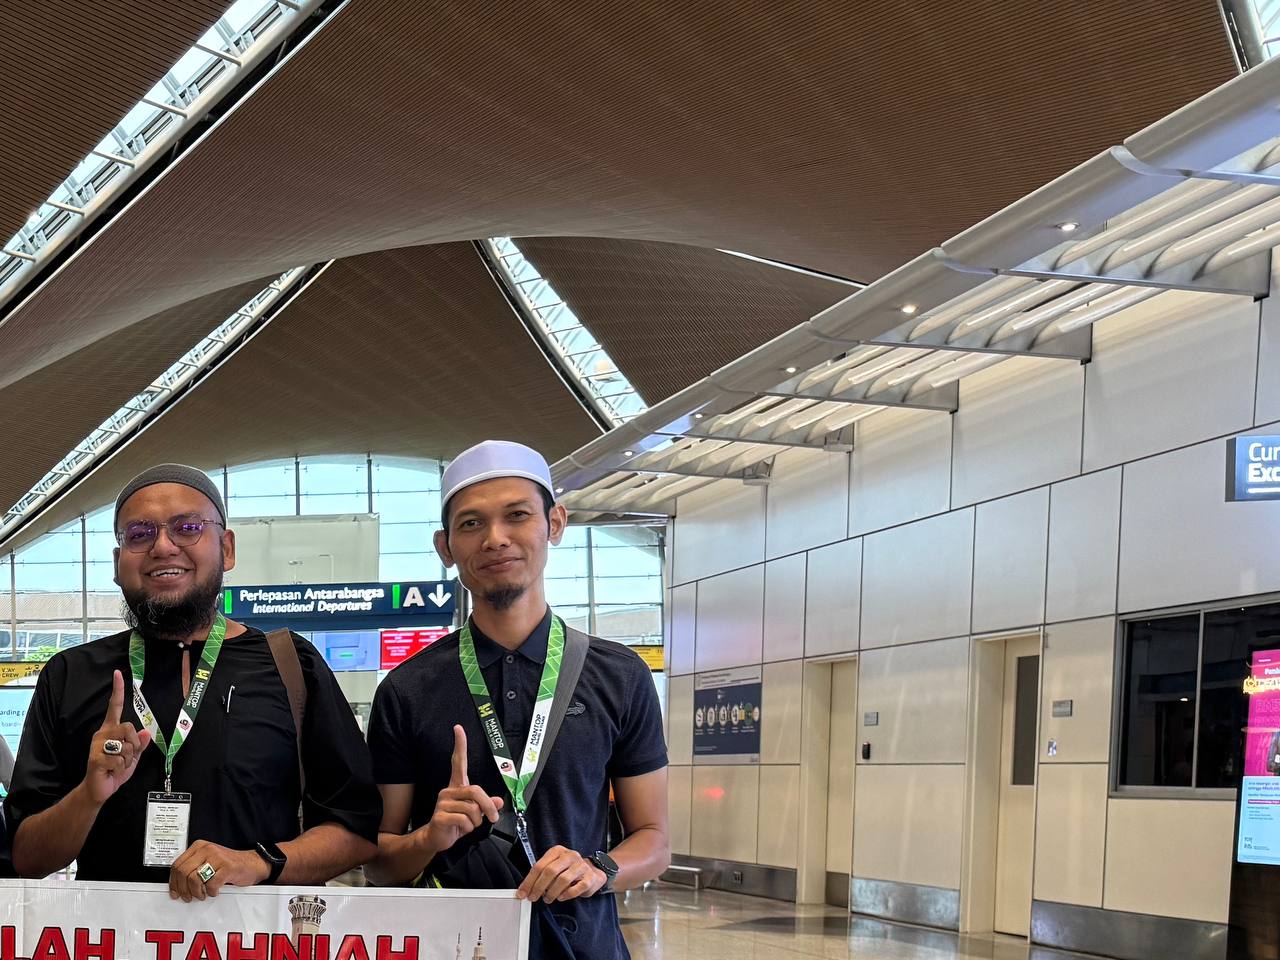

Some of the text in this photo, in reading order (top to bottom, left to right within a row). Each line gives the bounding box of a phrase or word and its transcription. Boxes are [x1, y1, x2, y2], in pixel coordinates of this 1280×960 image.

[240, 586, 425, 608] Perlepasan Antarabangsa A
[252, 601, 373, 614] International Departures
[192, 681, 205, 709] MANTOP
[489, 717, 505, 748] MANTOP
[530, 713, 542, 746] MANTOP
